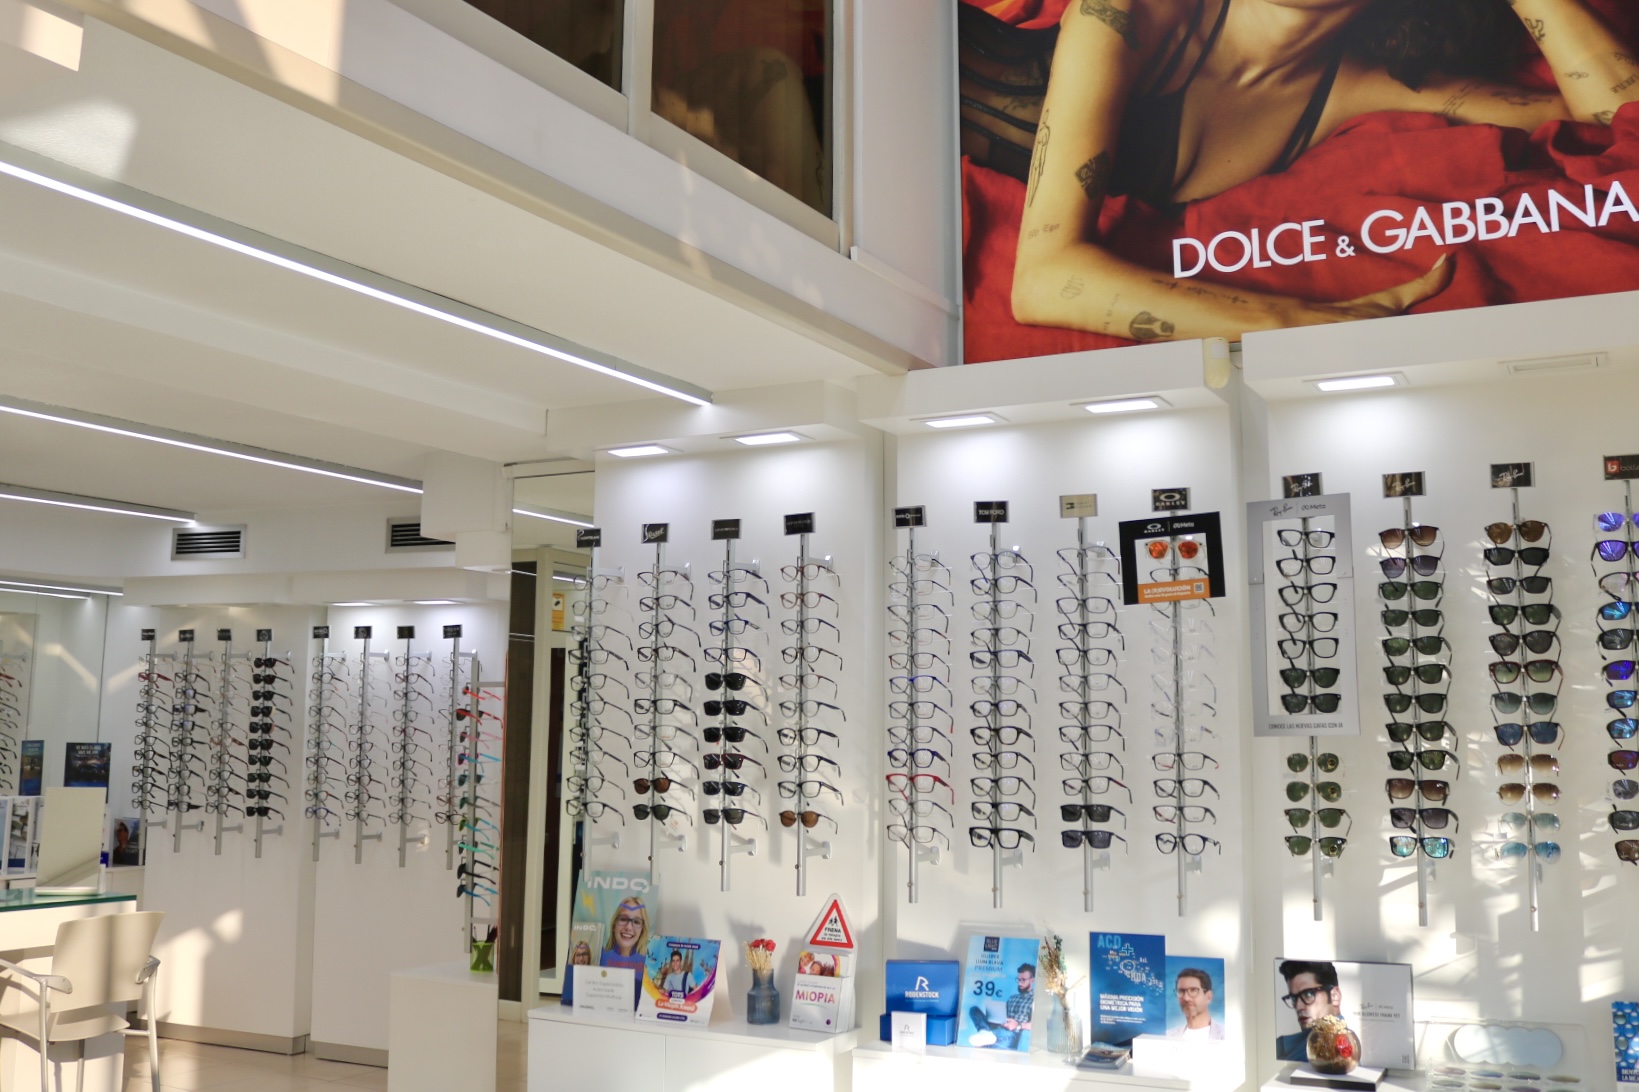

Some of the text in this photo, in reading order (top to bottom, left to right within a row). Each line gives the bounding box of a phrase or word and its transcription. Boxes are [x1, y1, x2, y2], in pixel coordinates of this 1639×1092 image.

[1172, 180, 1639, 278] DOLCE & GABBANA
[1097, 934, 1121, 949] ACD
[973, 980, 1003, 997] 39€
[796, 990, 835, 1004] MIOPIA
